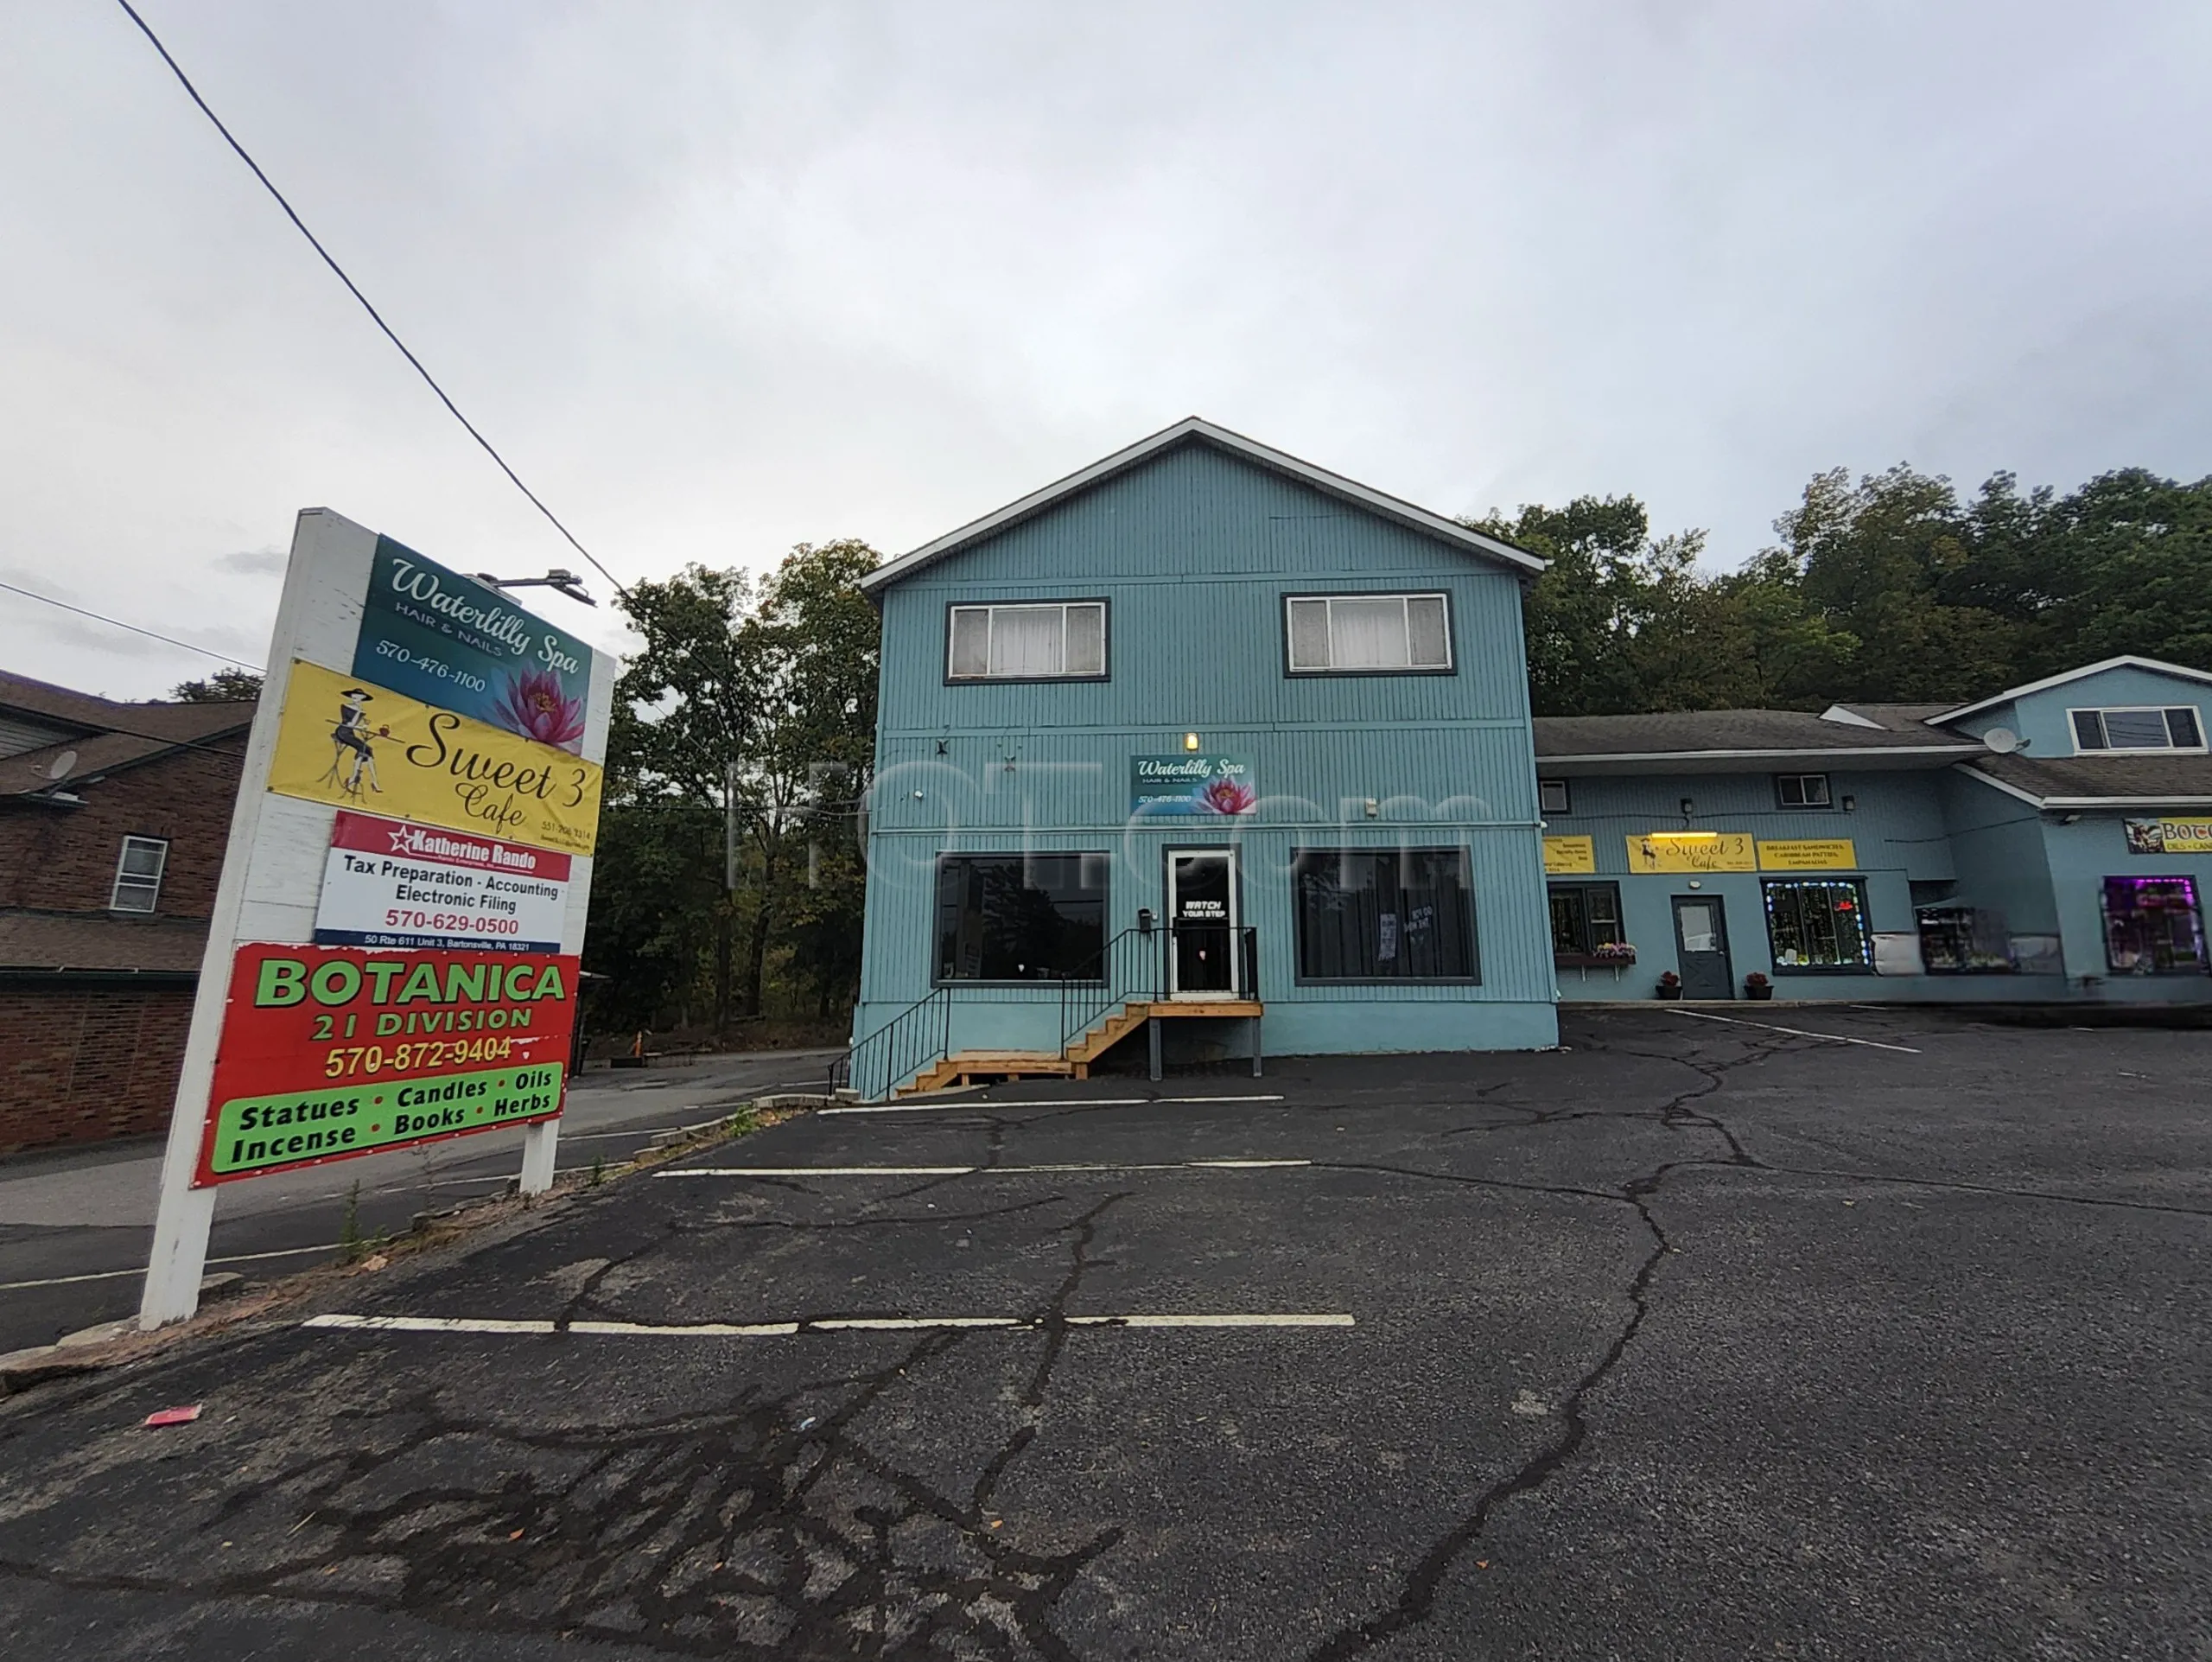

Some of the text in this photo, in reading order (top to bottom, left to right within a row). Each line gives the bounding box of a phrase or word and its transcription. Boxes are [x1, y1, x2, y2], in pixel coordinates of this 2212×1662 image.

[392, 558, 579, 674] Waterlilly Spa
[396, 602, 503, 657] HAIR & NAILS
[376, 640, 486, 692] 570-476-1100
[406, 713, 587, 808] Sweet 3
[1138, 758, 1245, 778] Waterlilly Spa
[455, 782, 527, 835] Cafe
[411, 829, 537, 870] Katherine Rando
[1666, 837, 1745, 856] Sweet 3
[2161, 823, 2212, 840] BOT
[344, 855, 376, 876] Tax
[381, 861, 473, 888] Preparation
[486, 876, 559, 901] Accounting
[1686, 855, 1718, 870] Cafe
[396, 884, 517, 915] Electronic Filing
[1185, 901, 1221, 910] WATCH
[385, 908, 518, 935] 570-629-0500
[365, 934, 530, 952] 50 Rte 611 Unit 3, Bartonsville, PA 18321
[254, 958, 566, 1008] BOTANICA
[377, 1008, 533, 1037] DIVISION
[324, 1036, 512, 1079] 570-872-9404
[239, 1070, 552, 1131] Statues Candles Oils
[231, 1092, 551, 1164] Incense Books Herbs
